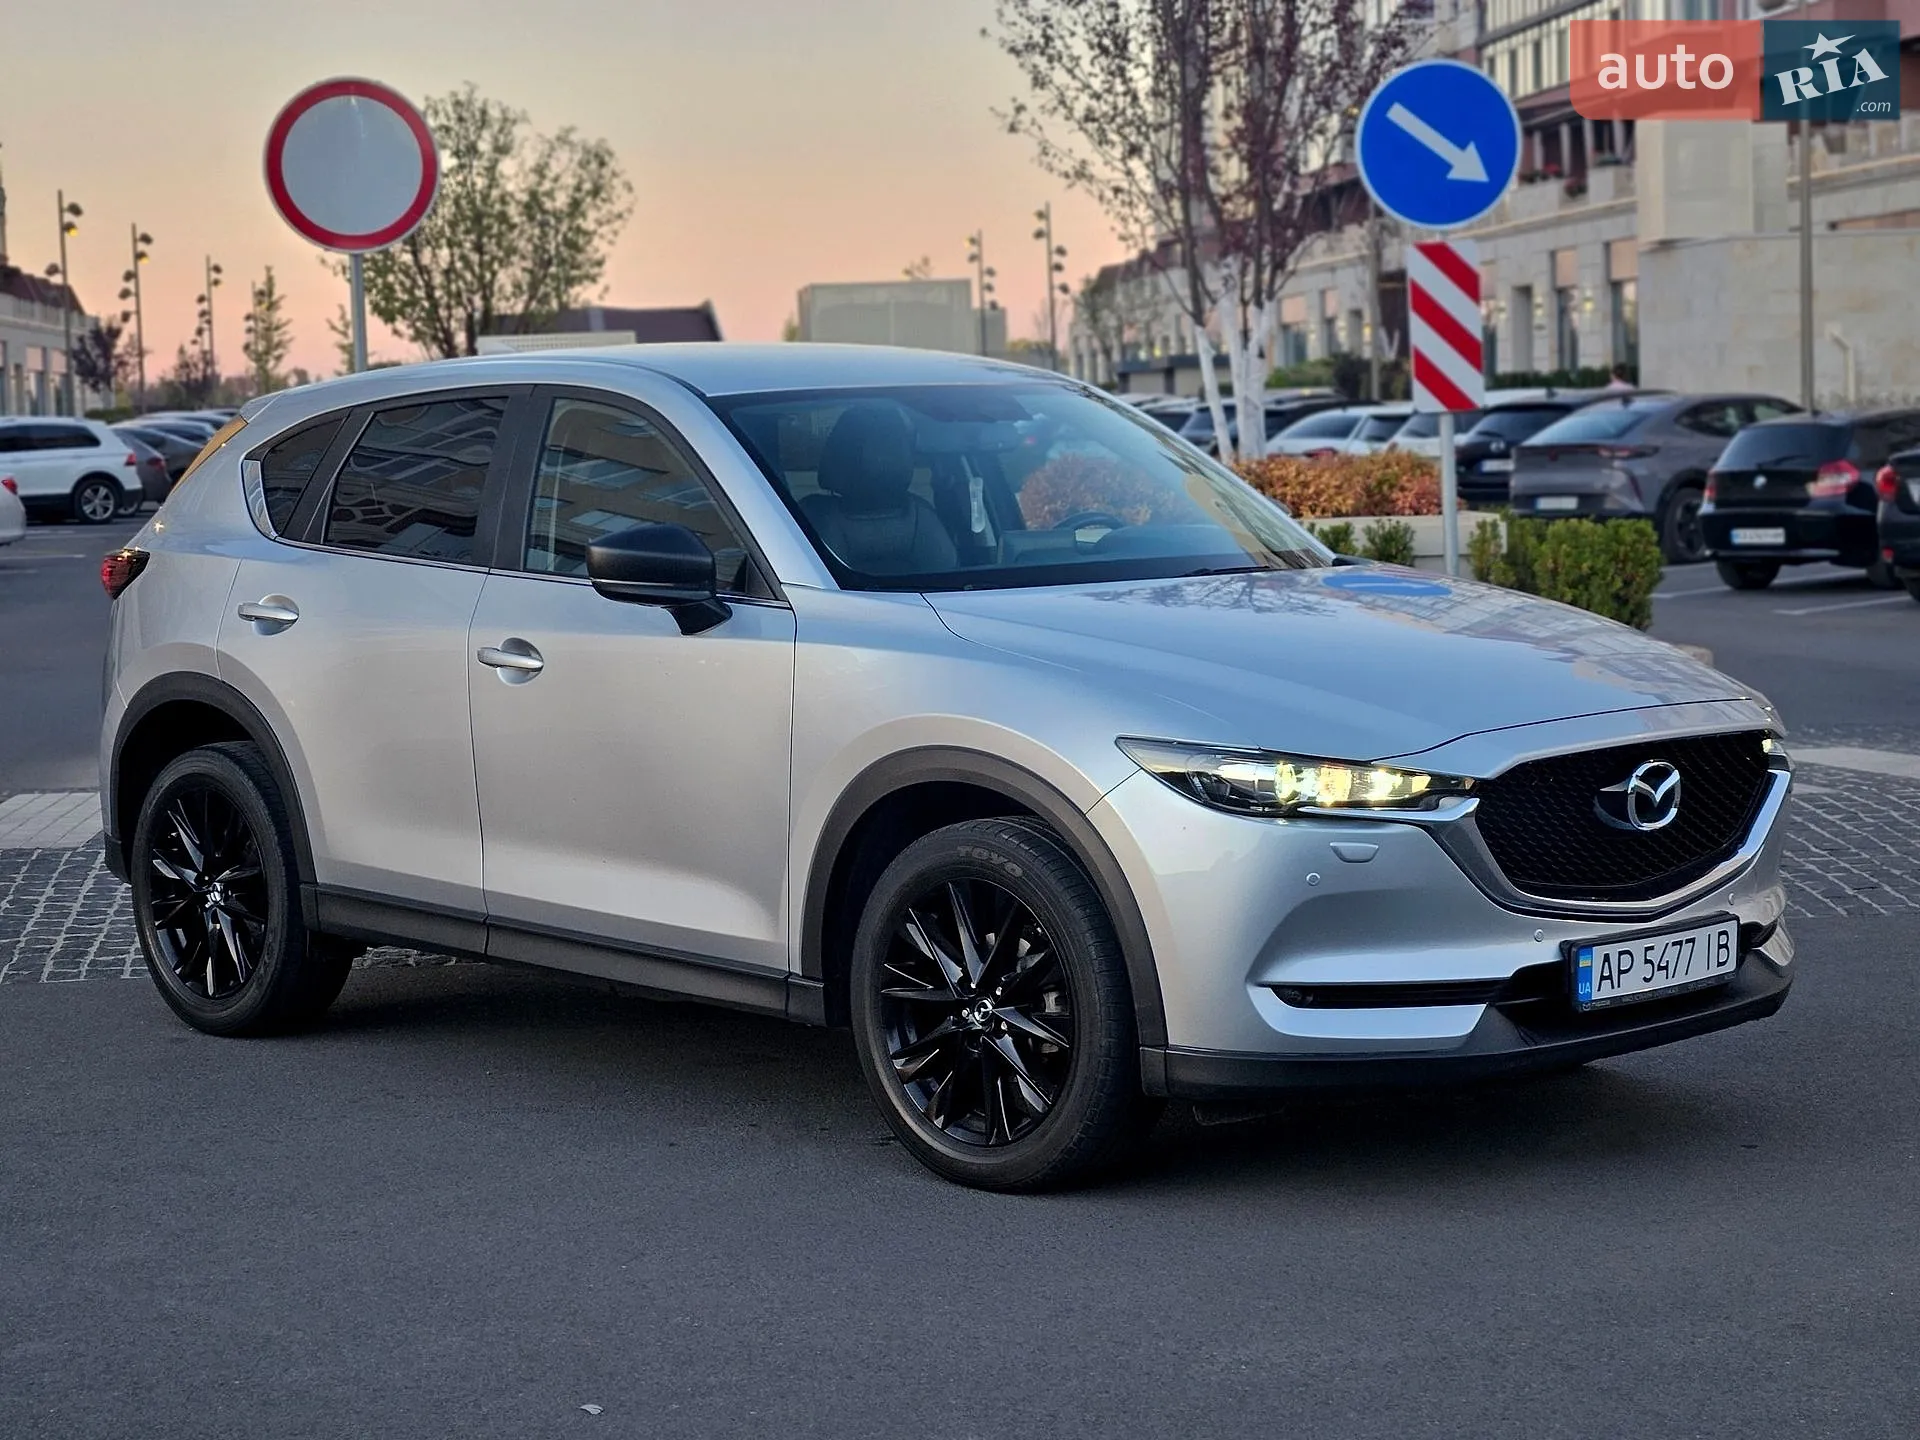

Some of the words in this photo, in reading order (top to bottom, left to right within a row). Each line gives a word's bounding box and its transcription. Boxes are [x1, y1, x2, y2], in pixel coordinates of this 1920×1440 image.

[957, 845, 1023, 878] TOYO
[1597, 949, 1634, 992] AP
[1642, 937, 1696, 983] 5477
[1707, 930, 1730, 971] IB
[1578, 982, 1592, 995] UA
